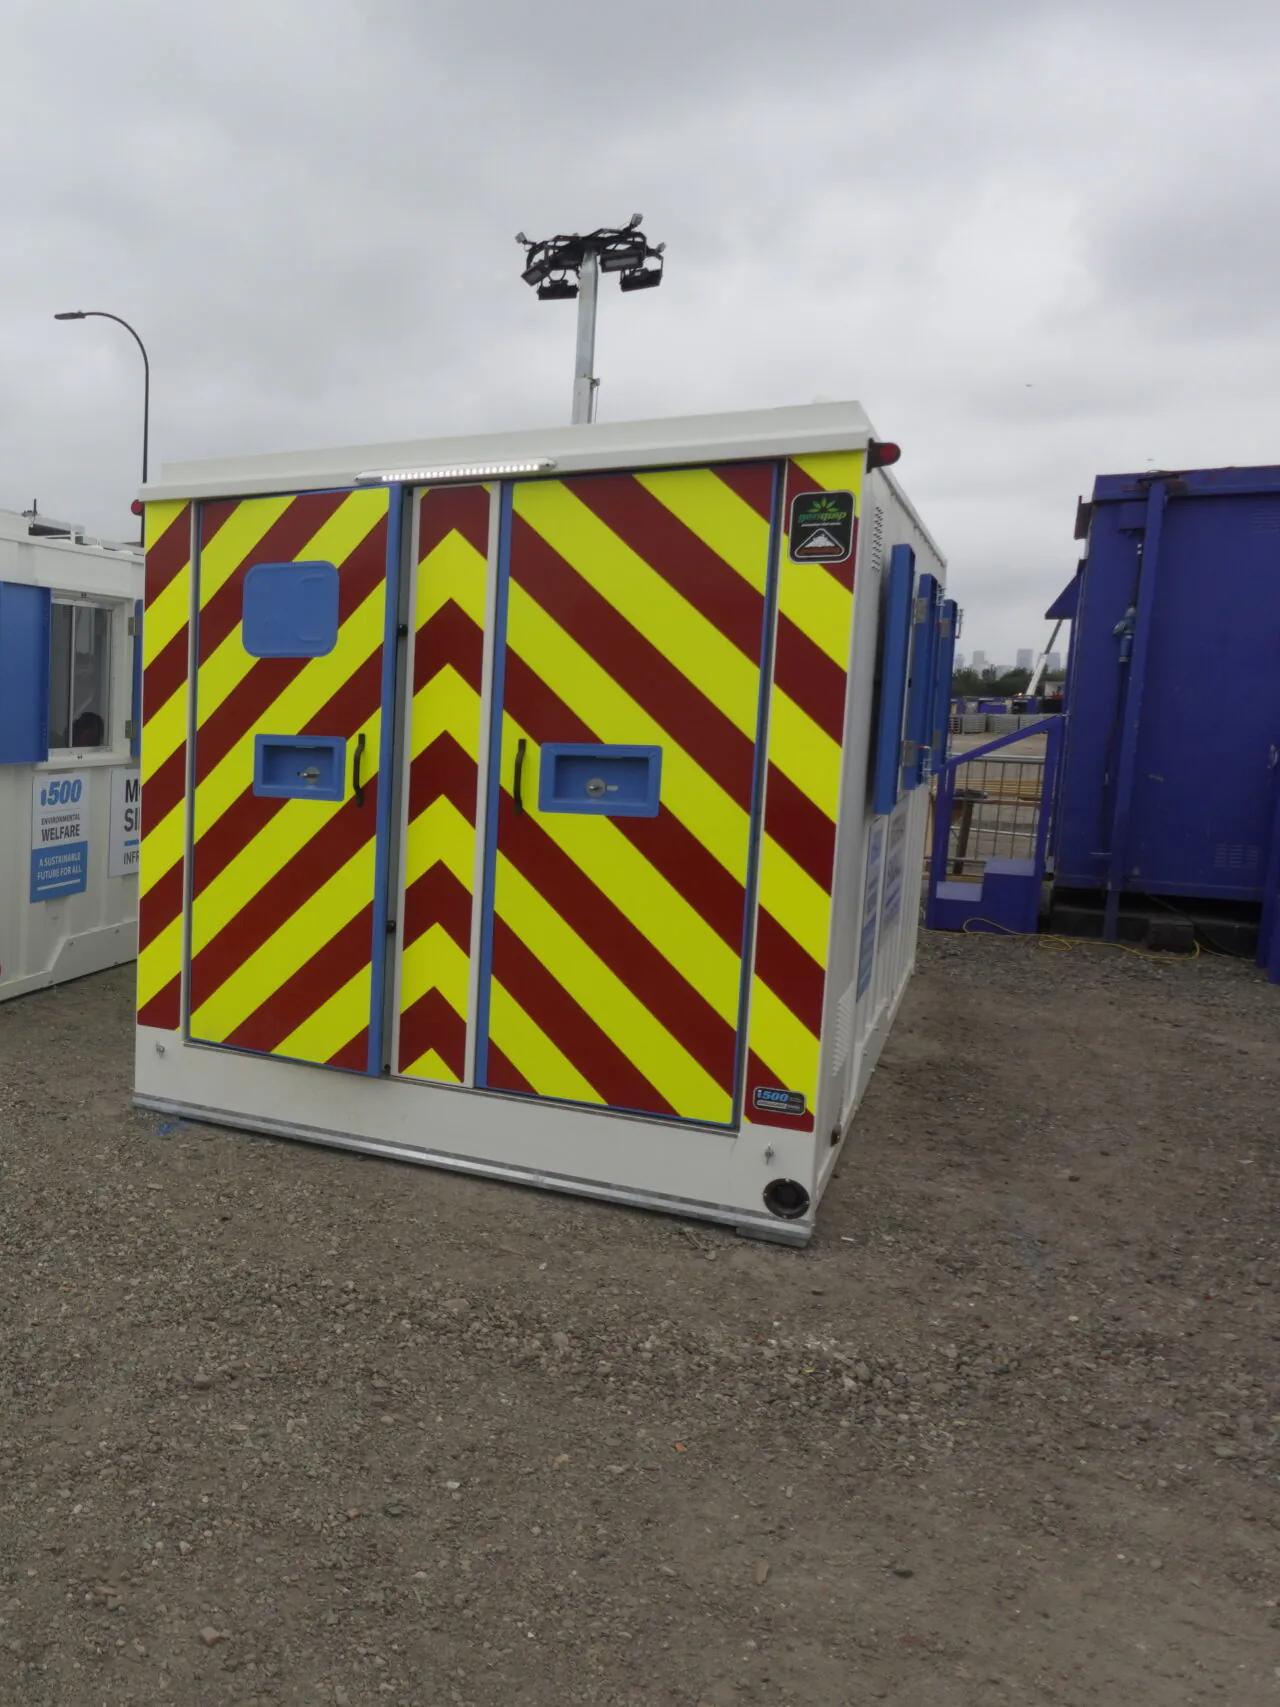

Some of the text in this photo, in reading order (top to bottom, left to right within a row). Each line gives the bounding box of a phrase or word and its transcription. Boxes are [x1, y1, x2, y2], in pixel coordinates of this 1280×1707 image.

[125, 779, 140, 803] M
[41, 813, 81, 826] ENVIRONMENTAL
[41, 823, 81, 842] WELFARE
[44, 851, 81, 866] SUSTAINABLE
[37, 862, 82, 881] FUTURE FOR ALL
